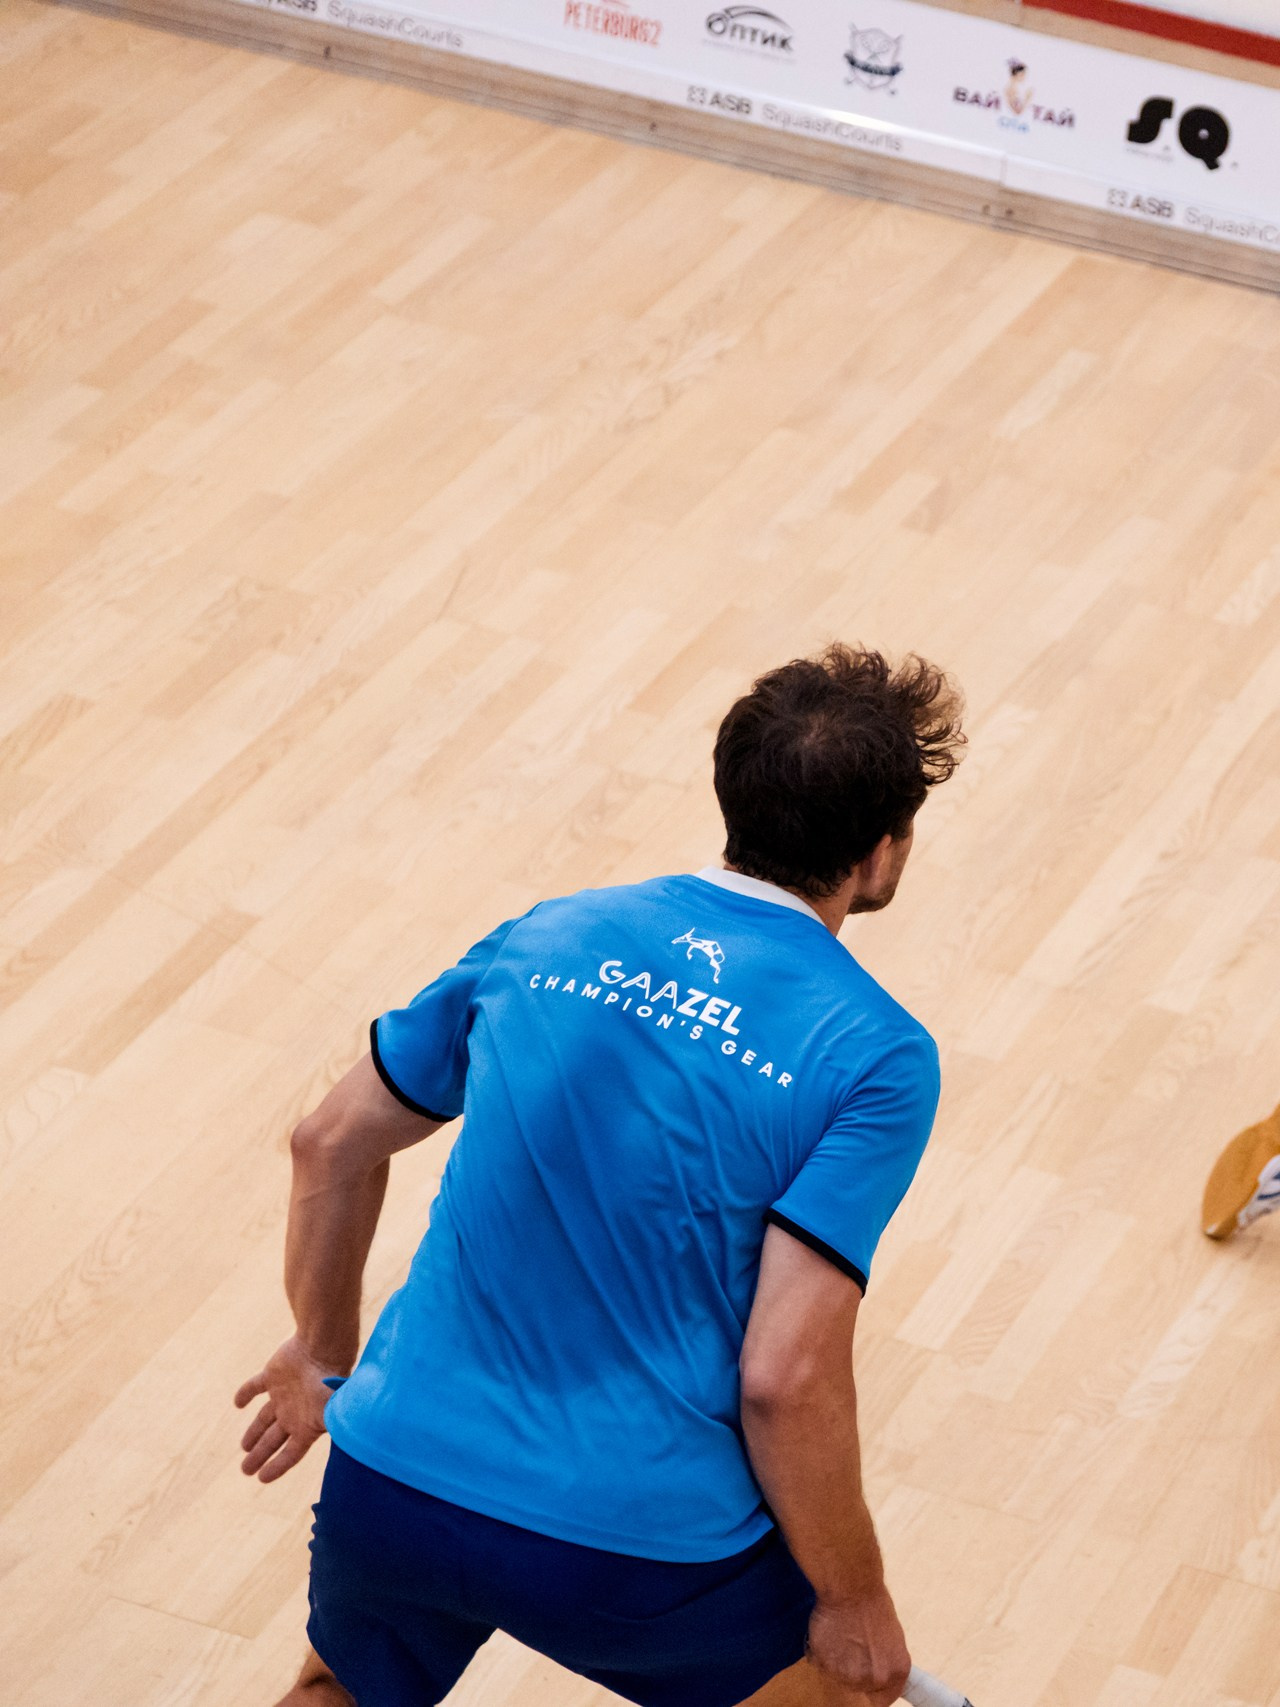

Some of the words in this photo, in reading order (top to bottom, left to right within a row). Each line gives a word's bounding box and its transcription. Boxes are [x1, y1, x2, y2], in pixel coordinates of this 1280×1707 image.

[710, 93, 752, 115] ASB
[762, 103, 902, 151] SquashCourts
[953, 87, 1001, 111] ВАЙ
[1032, 103, 1074, 128] ТАЙ
[1130, 197, 1175, 221] ASB
[599, 960, 743, 1036] GAAZEL
[529, 973, 704, 1040] CHAMPION'S
[720, 1039, 794, 1088] GEAR
